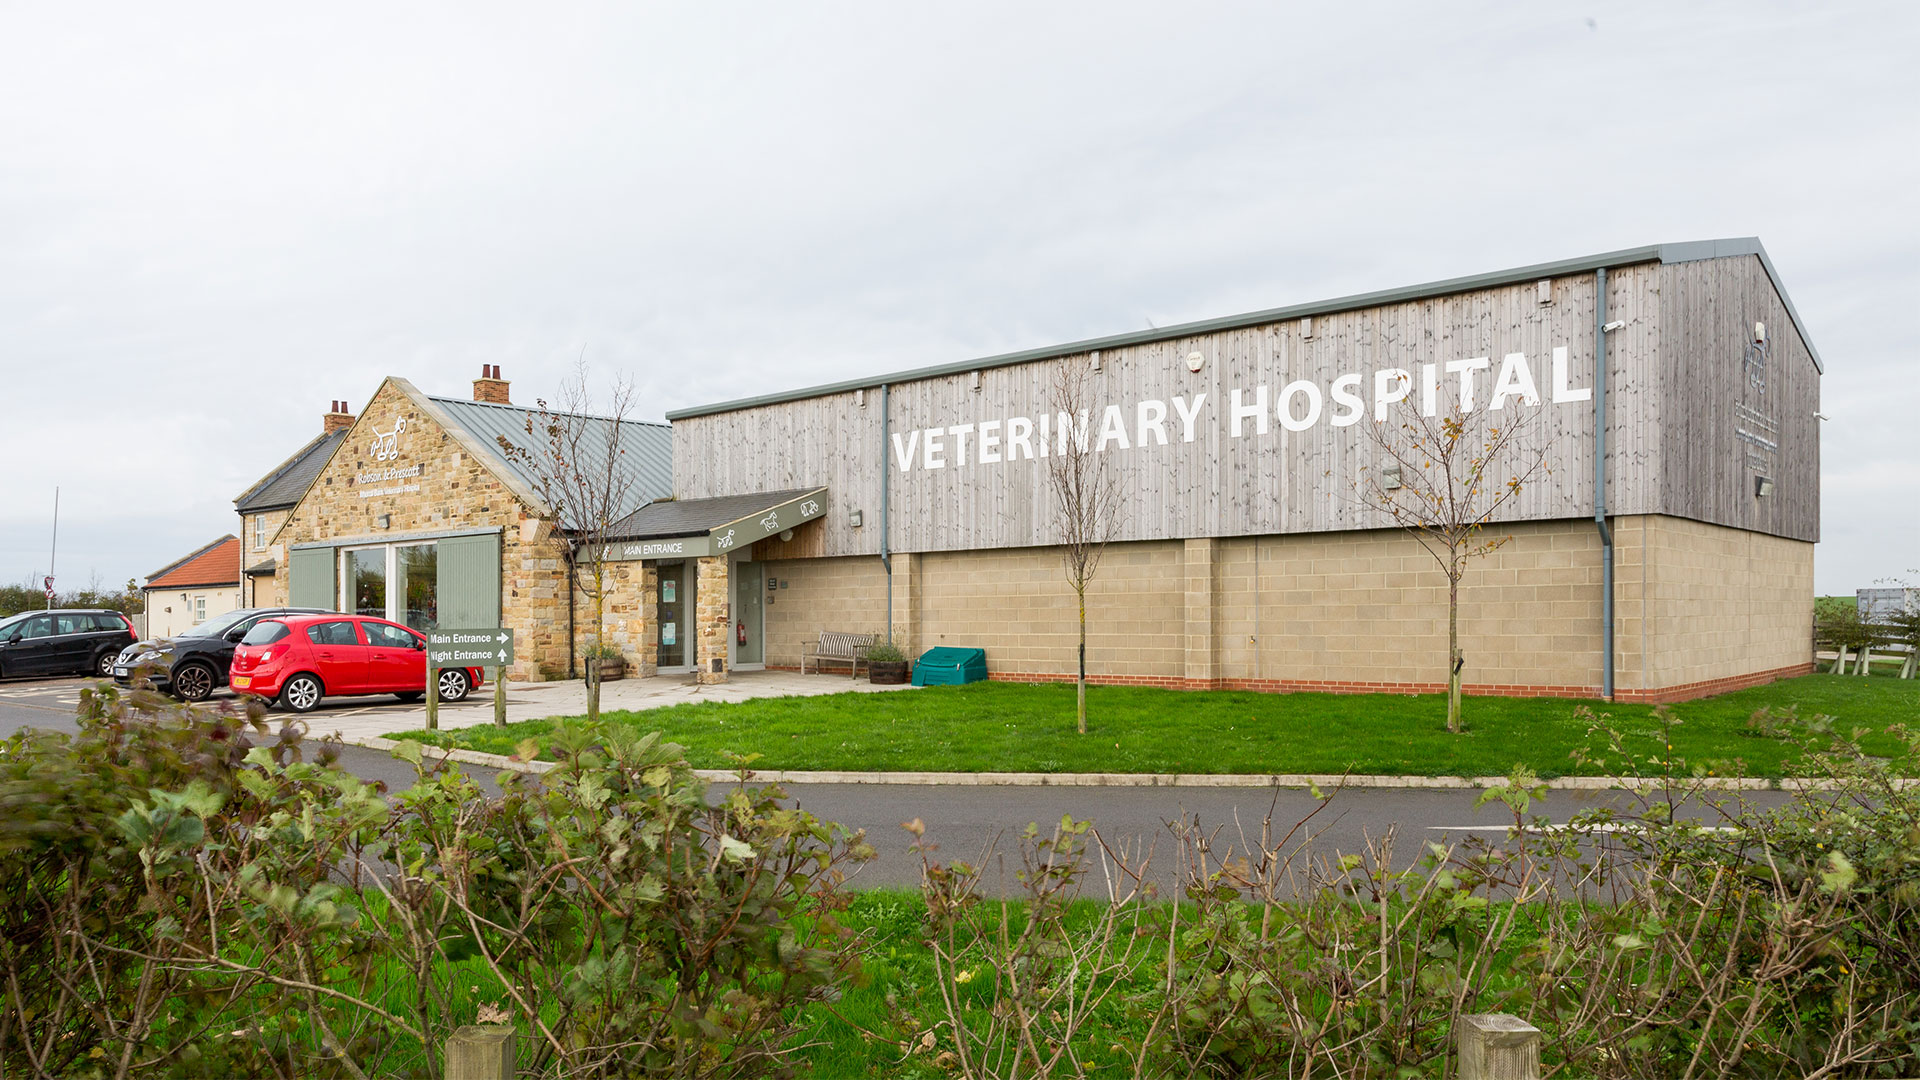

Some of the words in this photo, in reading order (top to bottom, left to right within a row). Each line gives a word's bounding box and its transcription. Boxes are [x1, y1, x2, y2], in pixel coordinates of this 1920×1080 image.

[892, 393, 1207, 472] VETERINARY
[1231, 346, 1591, 437] HOSPITAL
[358, 470, 382, 484] Robson
[390, 464, 420, 480] Prescott
[624, 545, 641, 555] MAIN
[643, 543, 683, 554] ENTRANCE
[430, 634, 451, 644] Main
[453, 633, 491, 643] Entrance
[430, 651, 452, 663] Night
[454, 650, 492, 660] Entrance
